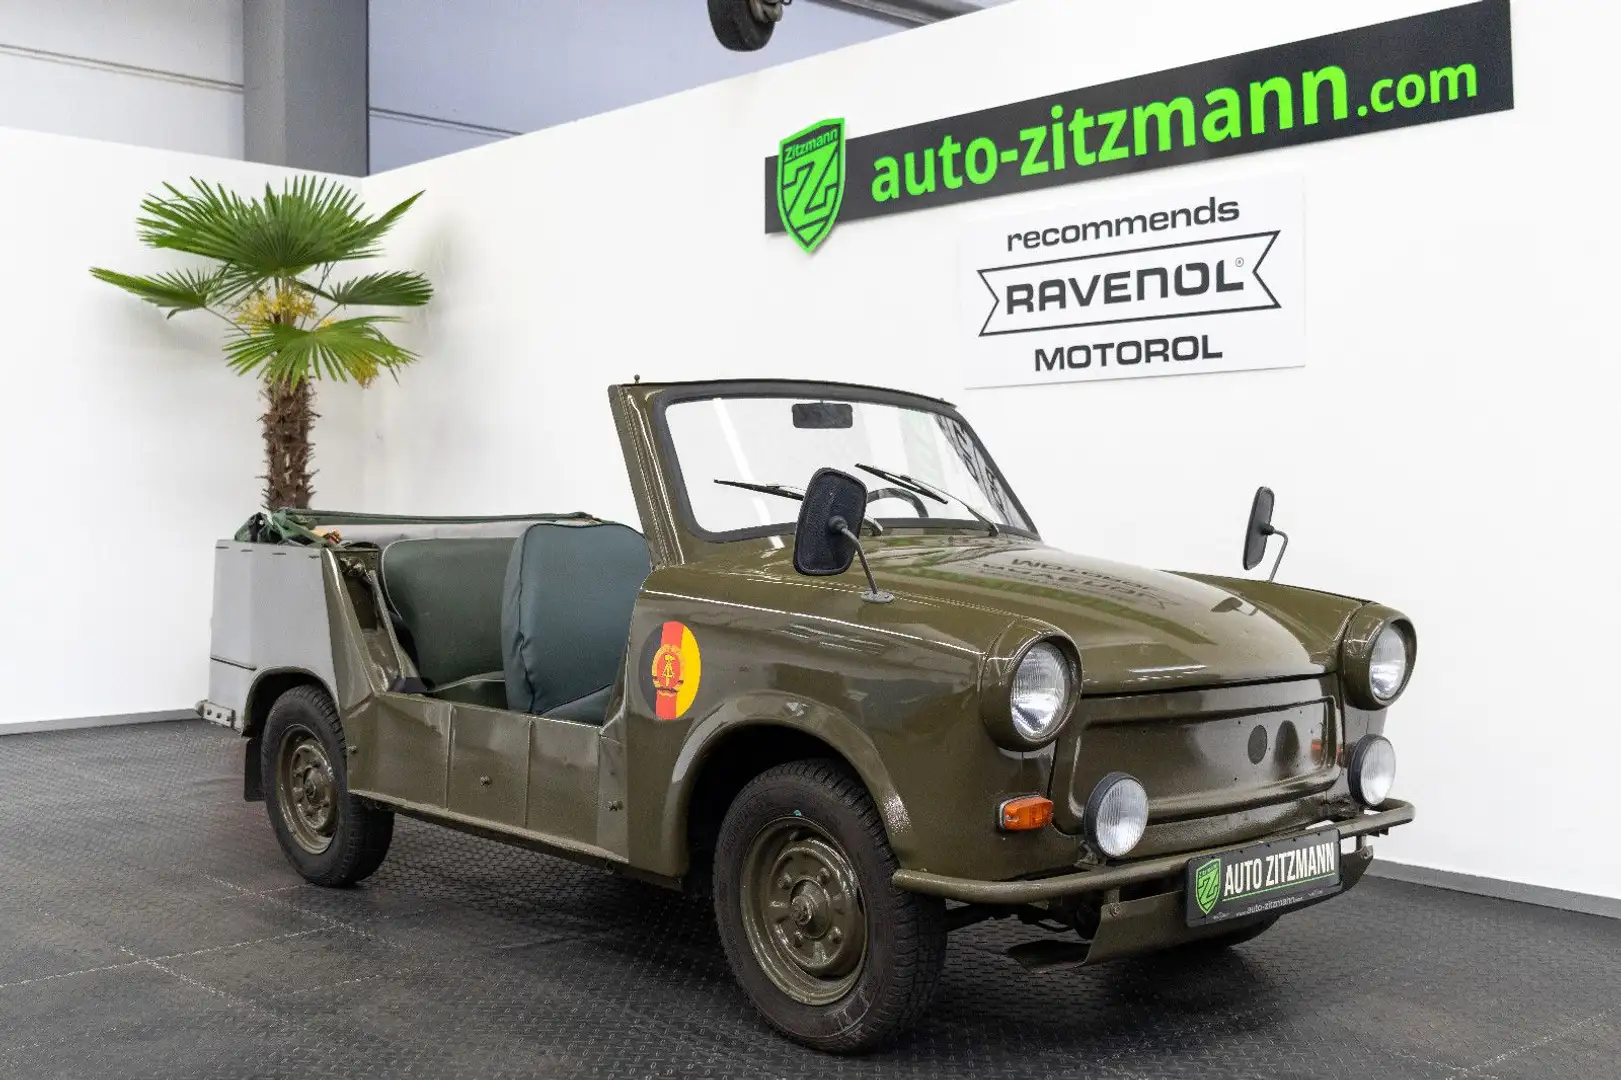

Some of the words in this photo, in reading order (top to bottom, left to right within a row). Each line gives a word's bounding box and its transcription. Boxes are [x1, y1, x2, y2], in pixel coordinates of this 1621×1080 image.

[784, 128, 838, 160] Zitzmann
[872, 63, 1477, 203] auto-zitzmann.com
[1008, 197, 1240, 252] recommends
[1035, 335, 1222, 372] MOTOROL
[1223, 857, 1262, 897] AUTO
[1265, 842, 1336, 887] ZITZMANN
